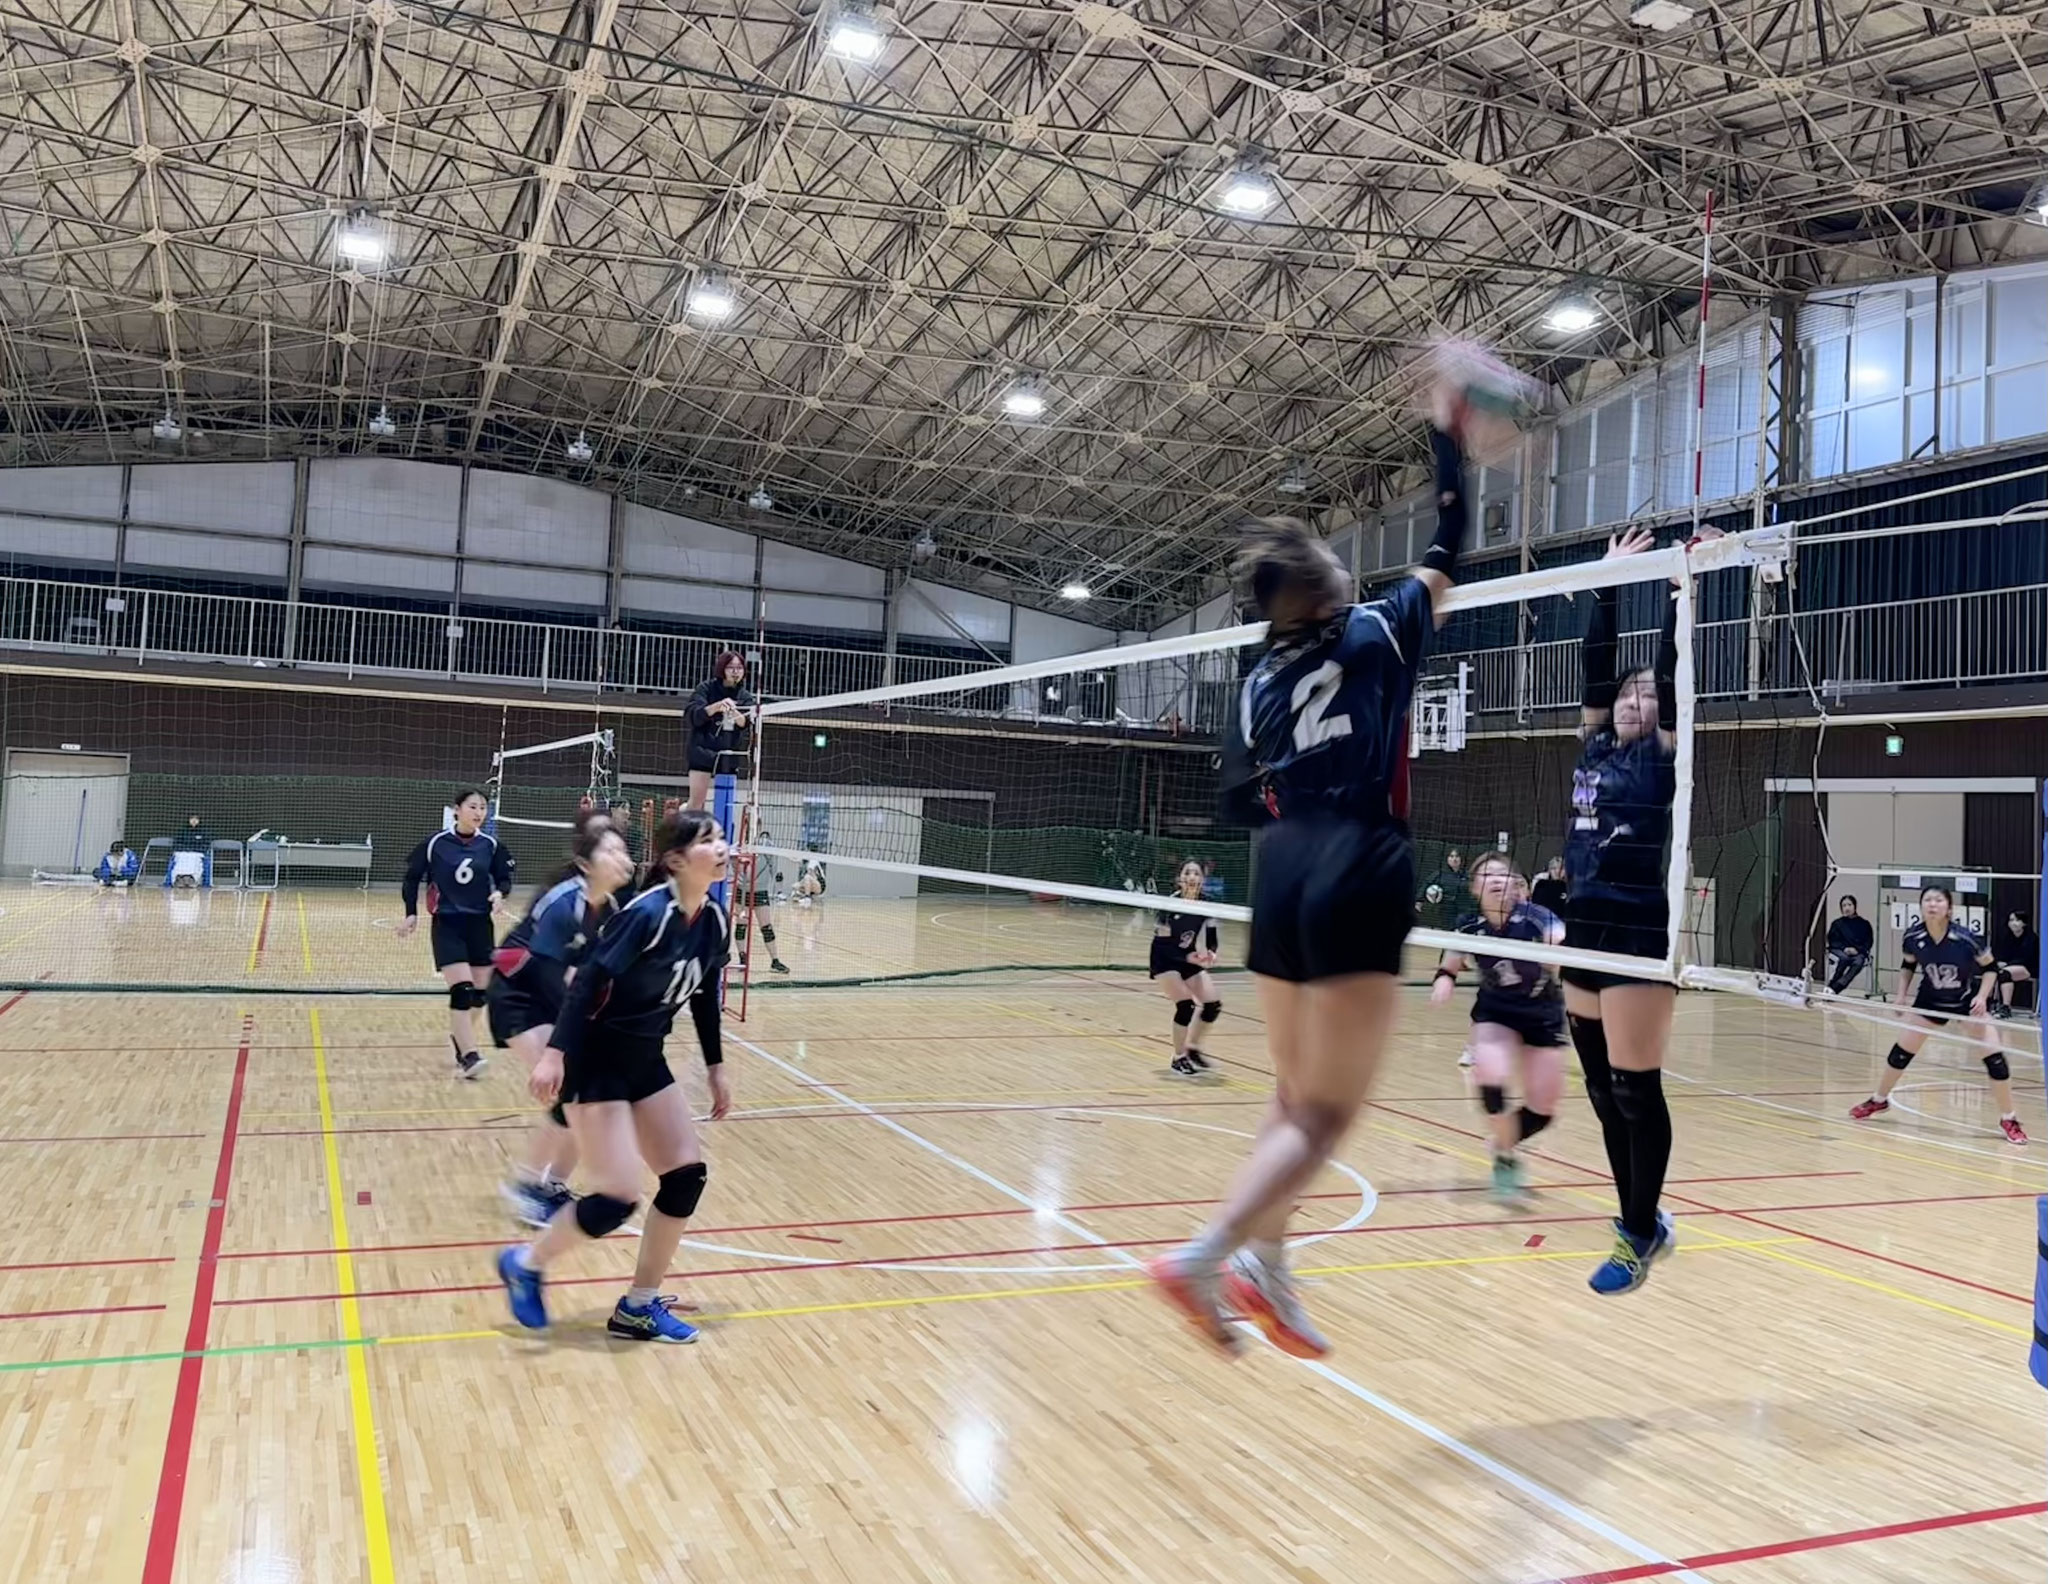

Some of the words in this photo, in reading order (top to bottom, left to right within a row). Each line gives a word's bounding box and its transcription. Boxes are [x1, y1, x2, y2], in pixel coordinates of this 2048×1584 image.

[1290, 659, 1353, 753] 2
[455, 857, 474, 885] 6
[660, 955, 703, 1005] 10
[1925, 962, 1962, 990] 12
